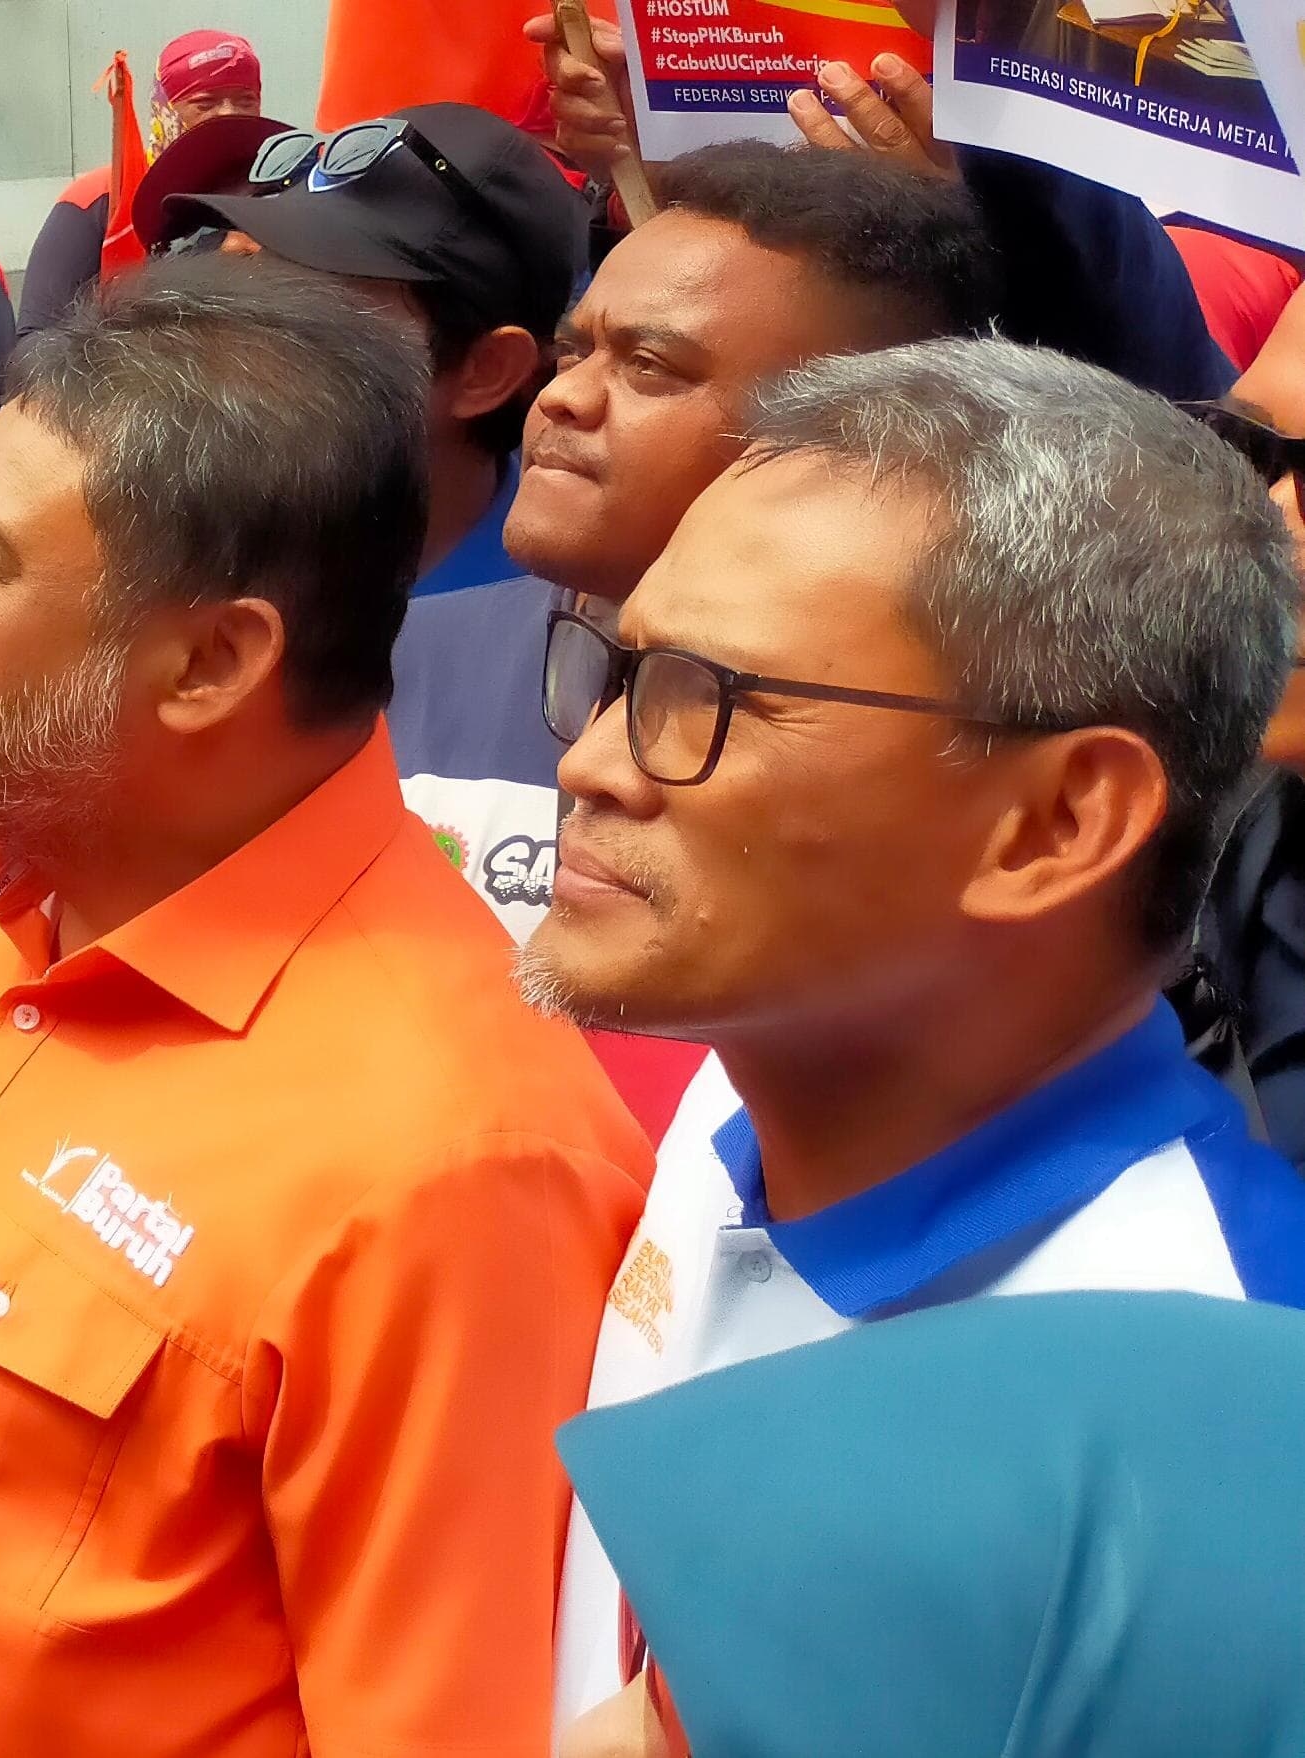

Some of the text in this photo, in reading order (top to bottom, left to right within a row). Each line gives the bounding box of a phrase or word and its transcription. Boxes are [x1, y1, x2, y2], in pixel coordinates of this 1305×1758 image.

[646, 0, 729, 17] #HOSTUM
[651, 26, 784, 48] #StopPHKBuruh
[674, 88, 745, 103] FEDERASI
[750, 89, 814, 104] SERIK
[990, 57, 1064, 91] FEDERASI
[1068, 78, 1132, 112] SERIKAT
[1136, 98, 1212, 136] PEKERJA
[1217, 120, 1278, 154] METAL
[484, 835, 555, 906] SA
